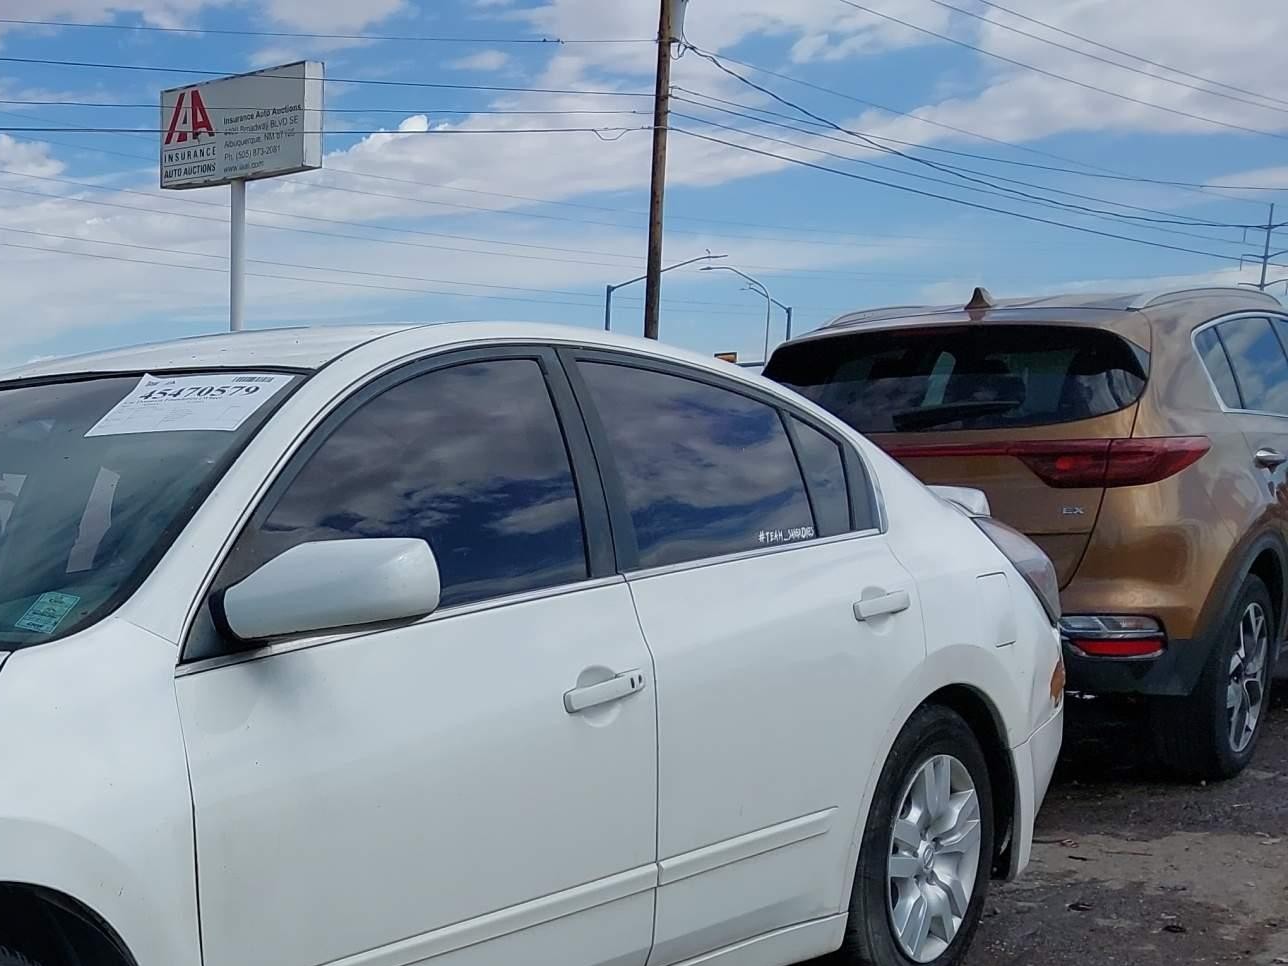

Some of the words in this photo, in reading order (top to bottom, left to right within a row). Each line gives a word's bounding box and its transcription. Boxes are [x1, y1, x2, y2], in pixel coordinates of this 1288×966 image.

[223, 113, 254, 125] Insurance
[256, 110, 270, 118] Auto
[270, 117, 288, 128] BLVD
[289, 115, 299, 124] SE
[164, 146, 216, 164] INSURANCE
[164, 168, 182, 179] AUTO
[183, 162, 216, 175] AUCTIONS
[139, 386, 260, 400] 45470579
[1062, 507, 1085, 515] EX
